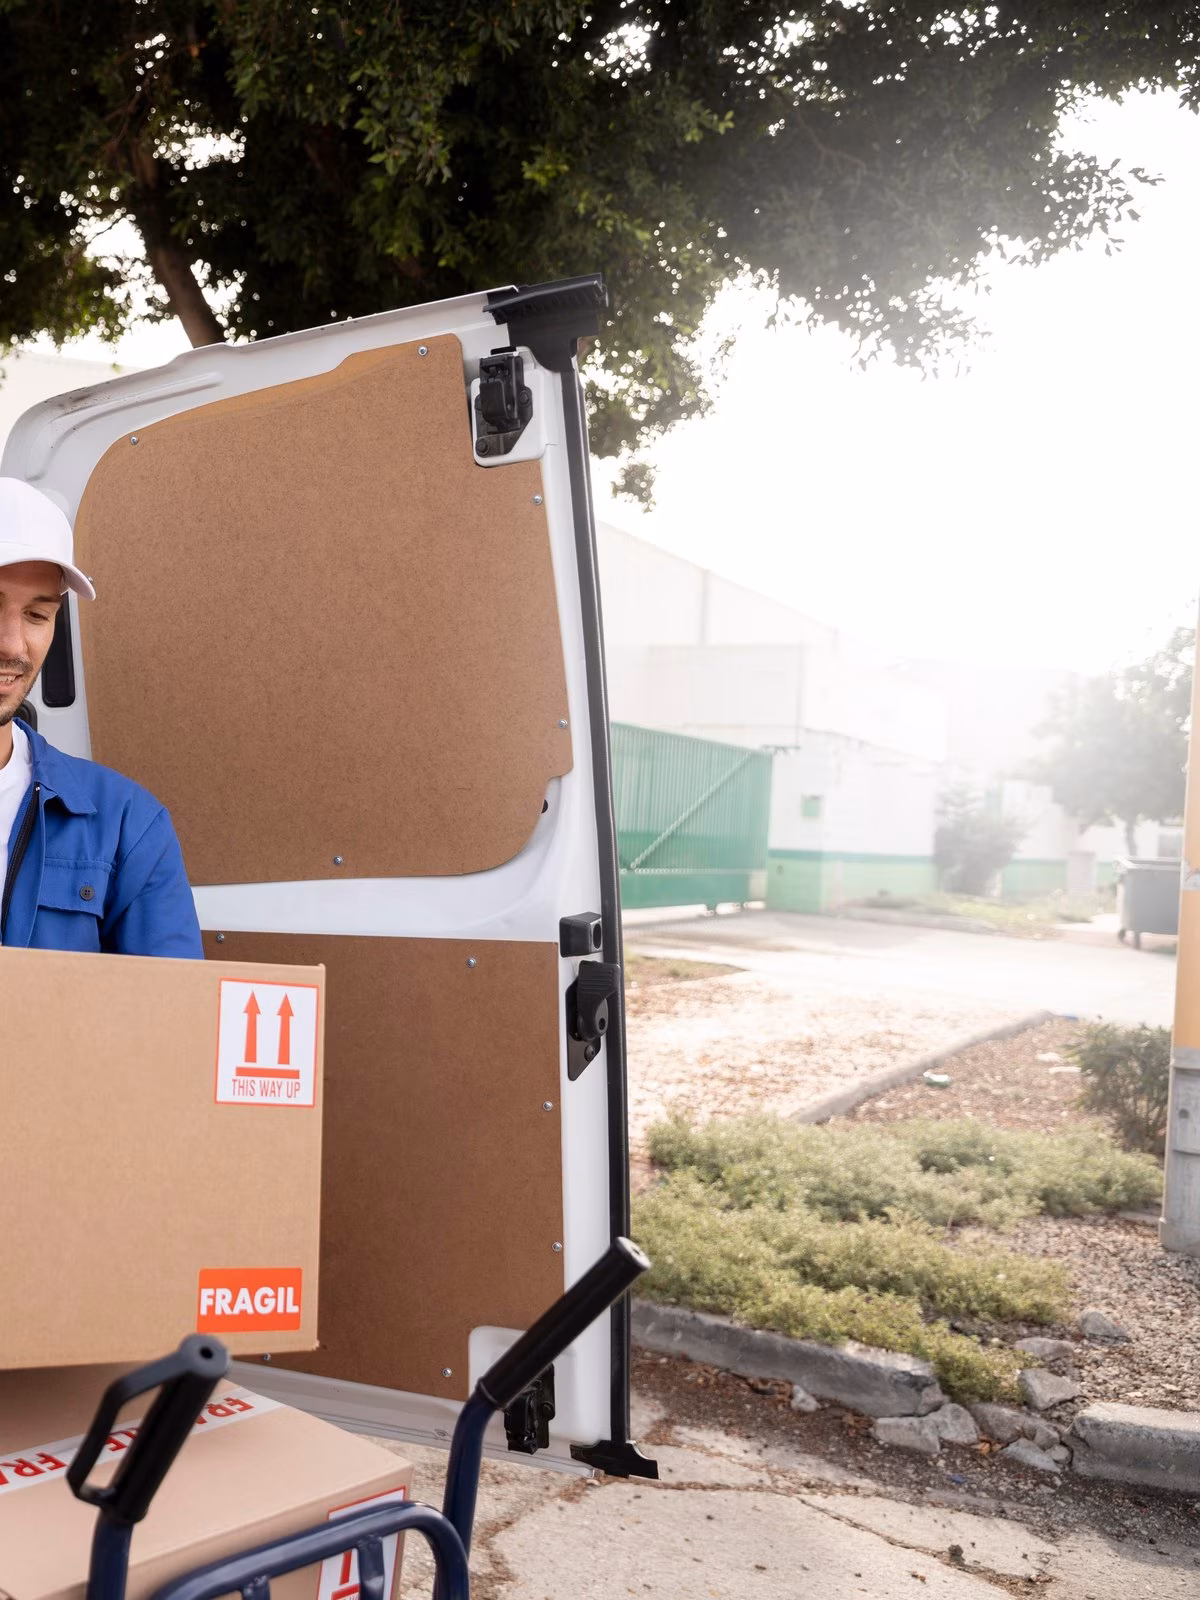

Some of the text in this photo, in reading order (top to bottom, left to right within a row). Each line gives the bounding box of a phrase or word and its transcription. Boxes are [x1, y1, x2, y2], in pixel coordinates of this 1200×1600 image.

[232, 1078, 301, 1099] THIS WAY UP
[200, 1286, 299, 1316] FRAGIL
